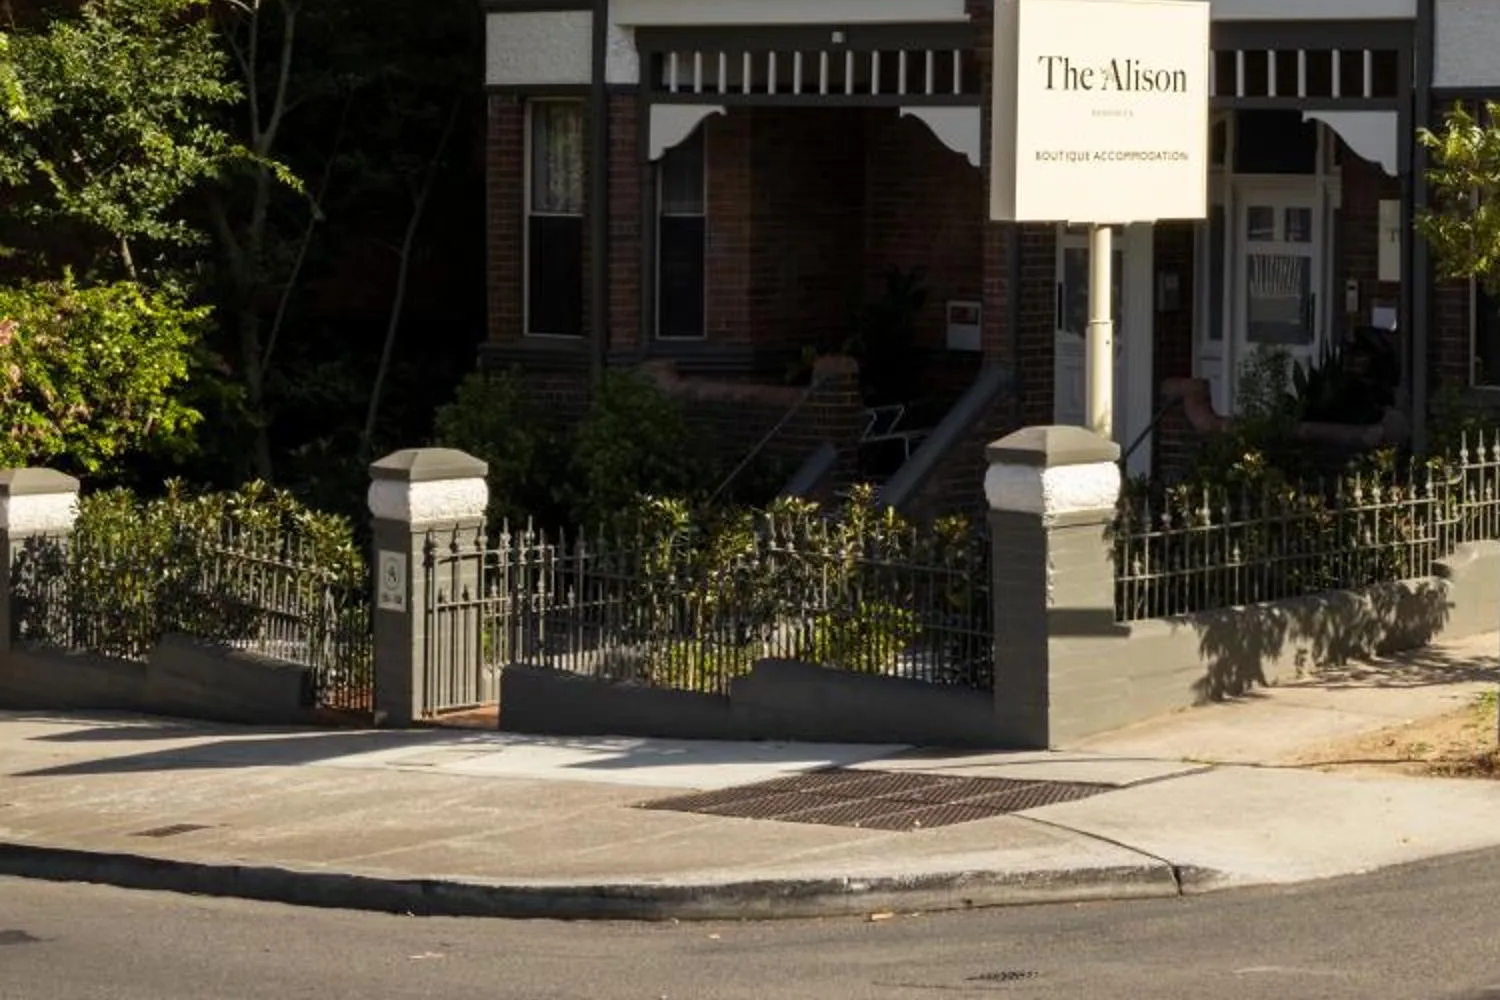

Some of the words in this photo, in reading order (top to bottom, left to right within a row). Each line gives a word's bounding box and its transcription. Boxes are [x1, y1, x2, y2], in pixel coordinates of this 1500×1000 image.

[1038, 55, 1094, 91] The
[1100, 57, 1188, 93] Alison
[1035, 151, 1090, 162] BOUTIQUE
[1093, 151, 1189, 162] ACCOMMODATION
